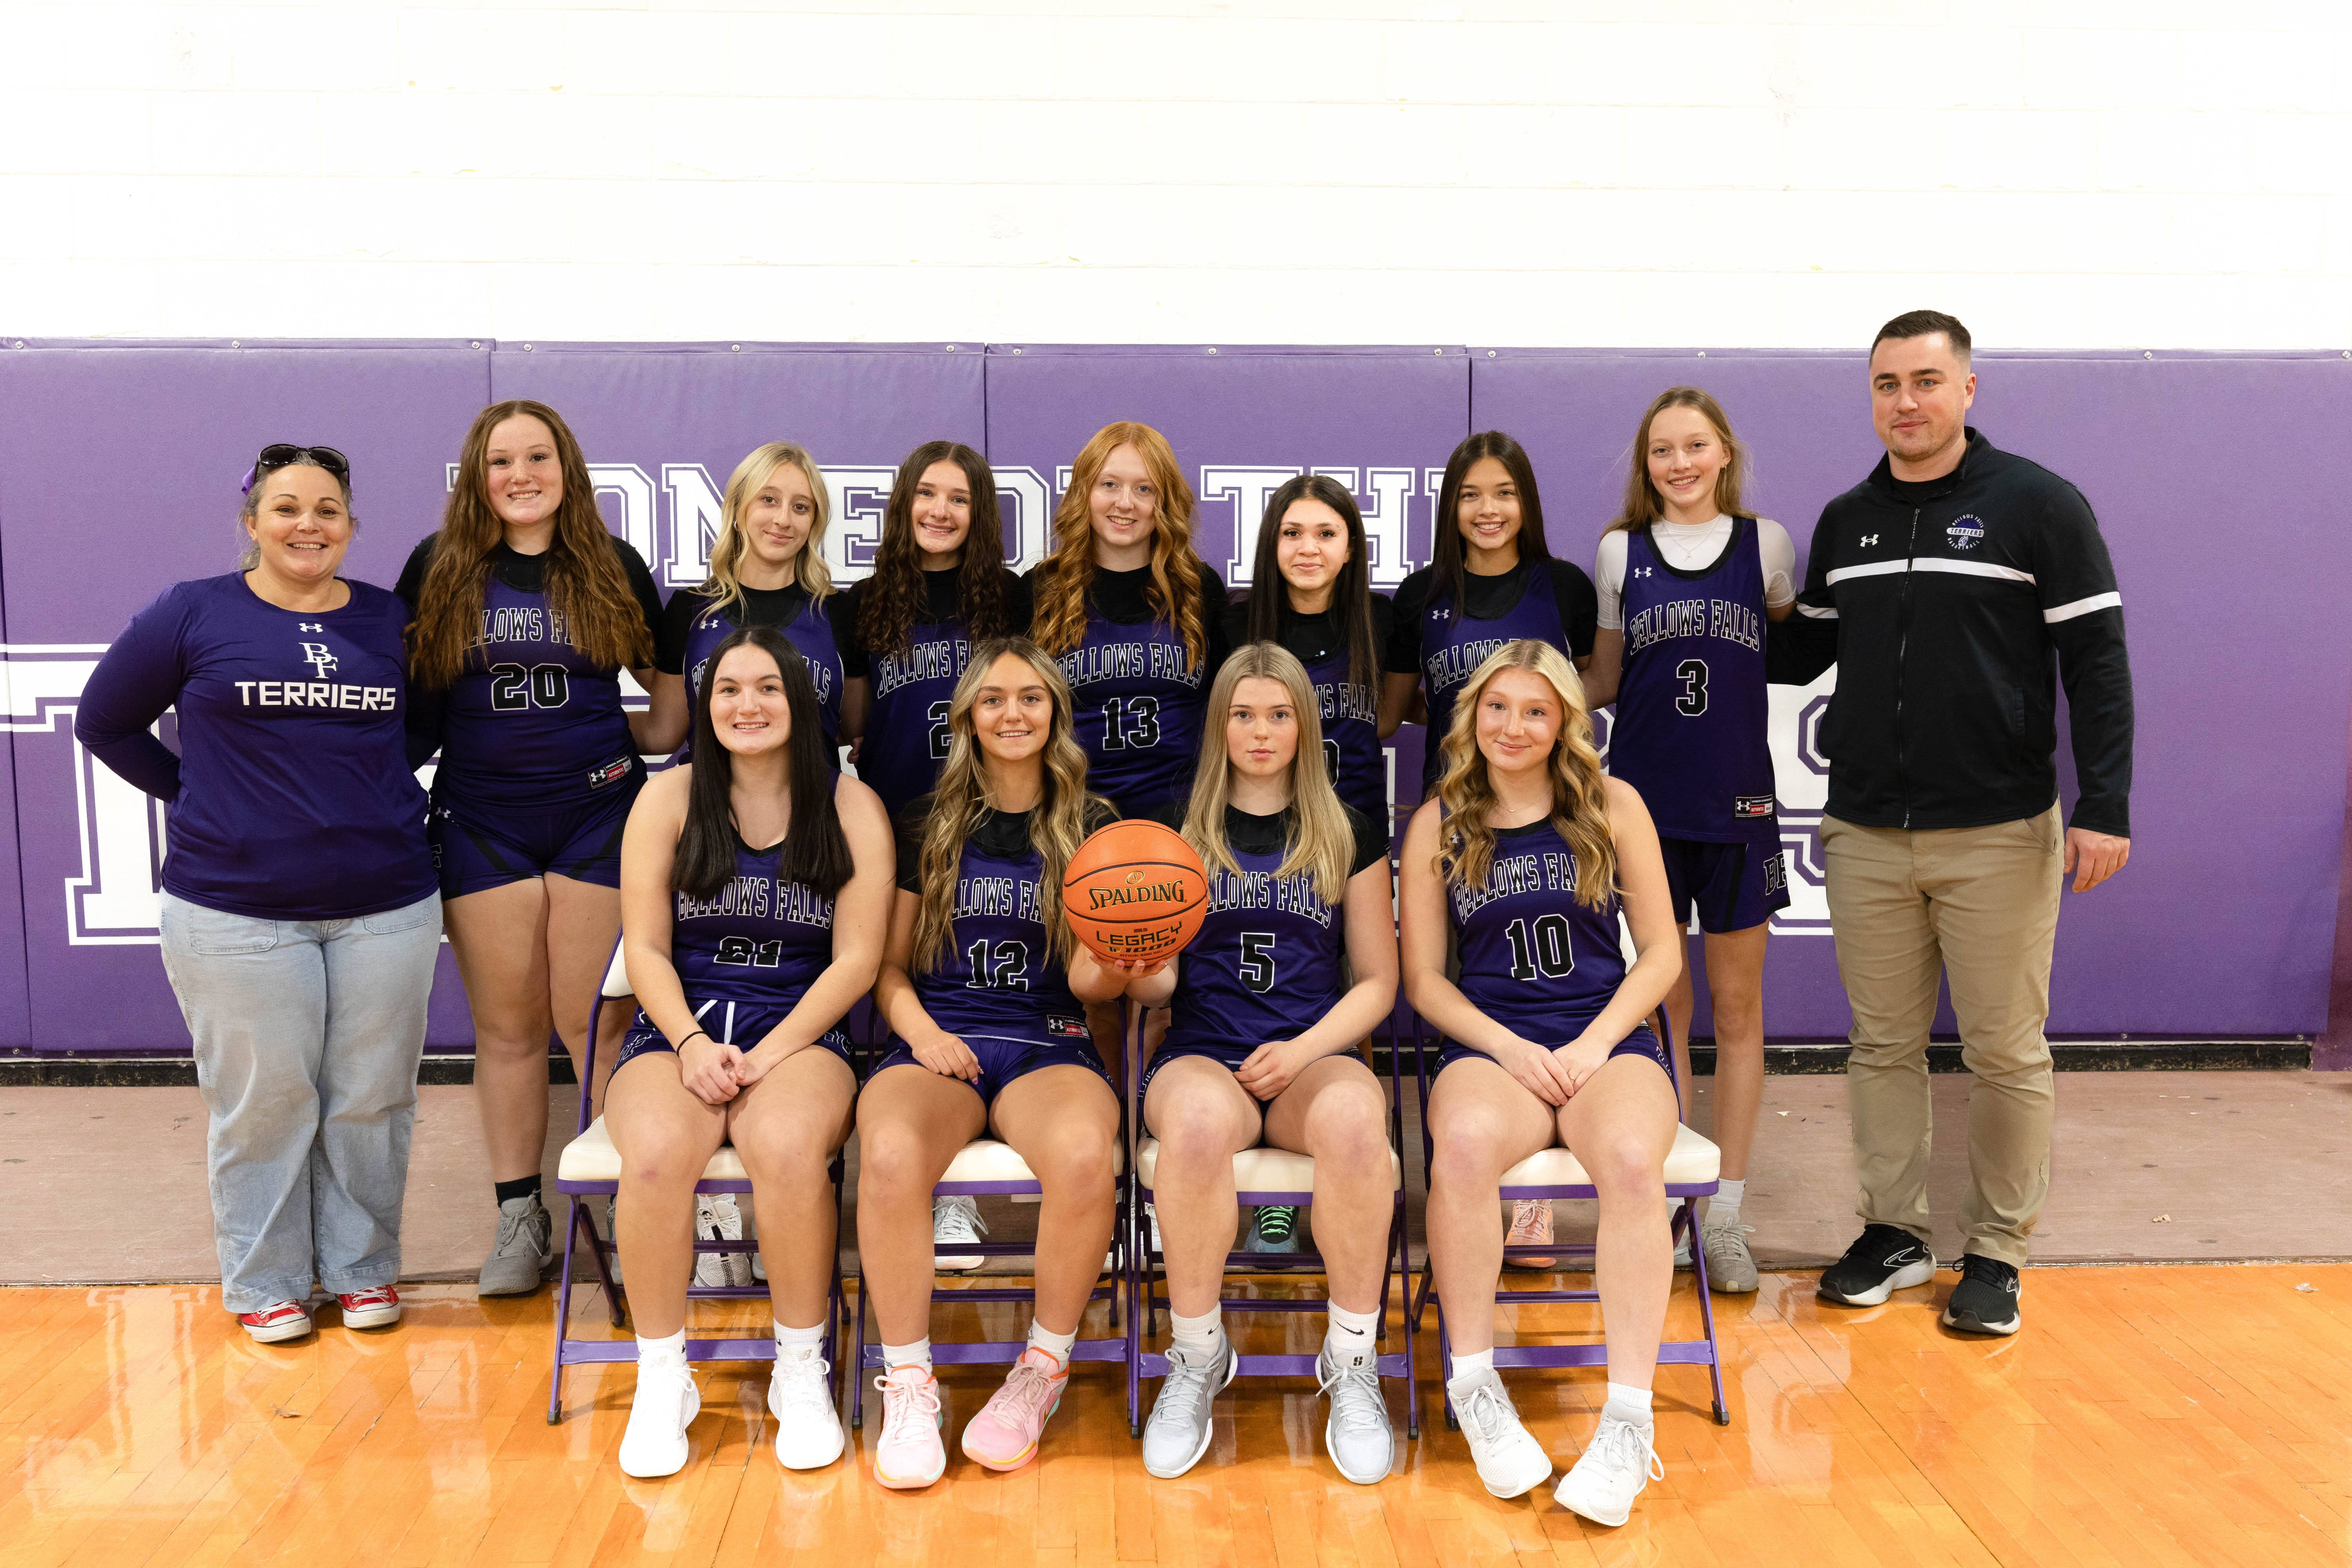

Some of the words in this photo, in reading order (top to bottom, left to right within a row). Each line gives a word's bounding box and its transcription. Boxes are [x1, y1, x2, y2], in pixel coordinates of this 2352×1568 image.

[1200, 465, 1446, 588] TH
[463, 608, 543, 650] LOWS
[1630, 600, 1705, 655] BELLOWS
[1711, 599, 1759, 652] FALLS
[235, 681, 396, 710] TERRIERS
[490, 663, 569, 711] 20
[1339, 683, 1378, 725] FALL
[1676, 659, 1708, 716] 3
[1102, 697, 1160, 750] 13
[608, 767, 624, 778] AUTHENTIC
[1089, 879, 1184, 911] SPALDING
[1096, 921, 1183, 946] LEGACY
[1505, 914, 1575, 981] 10
[966, 939, 1028, 992] 12
[1239, 932, 1275, 993] 5
